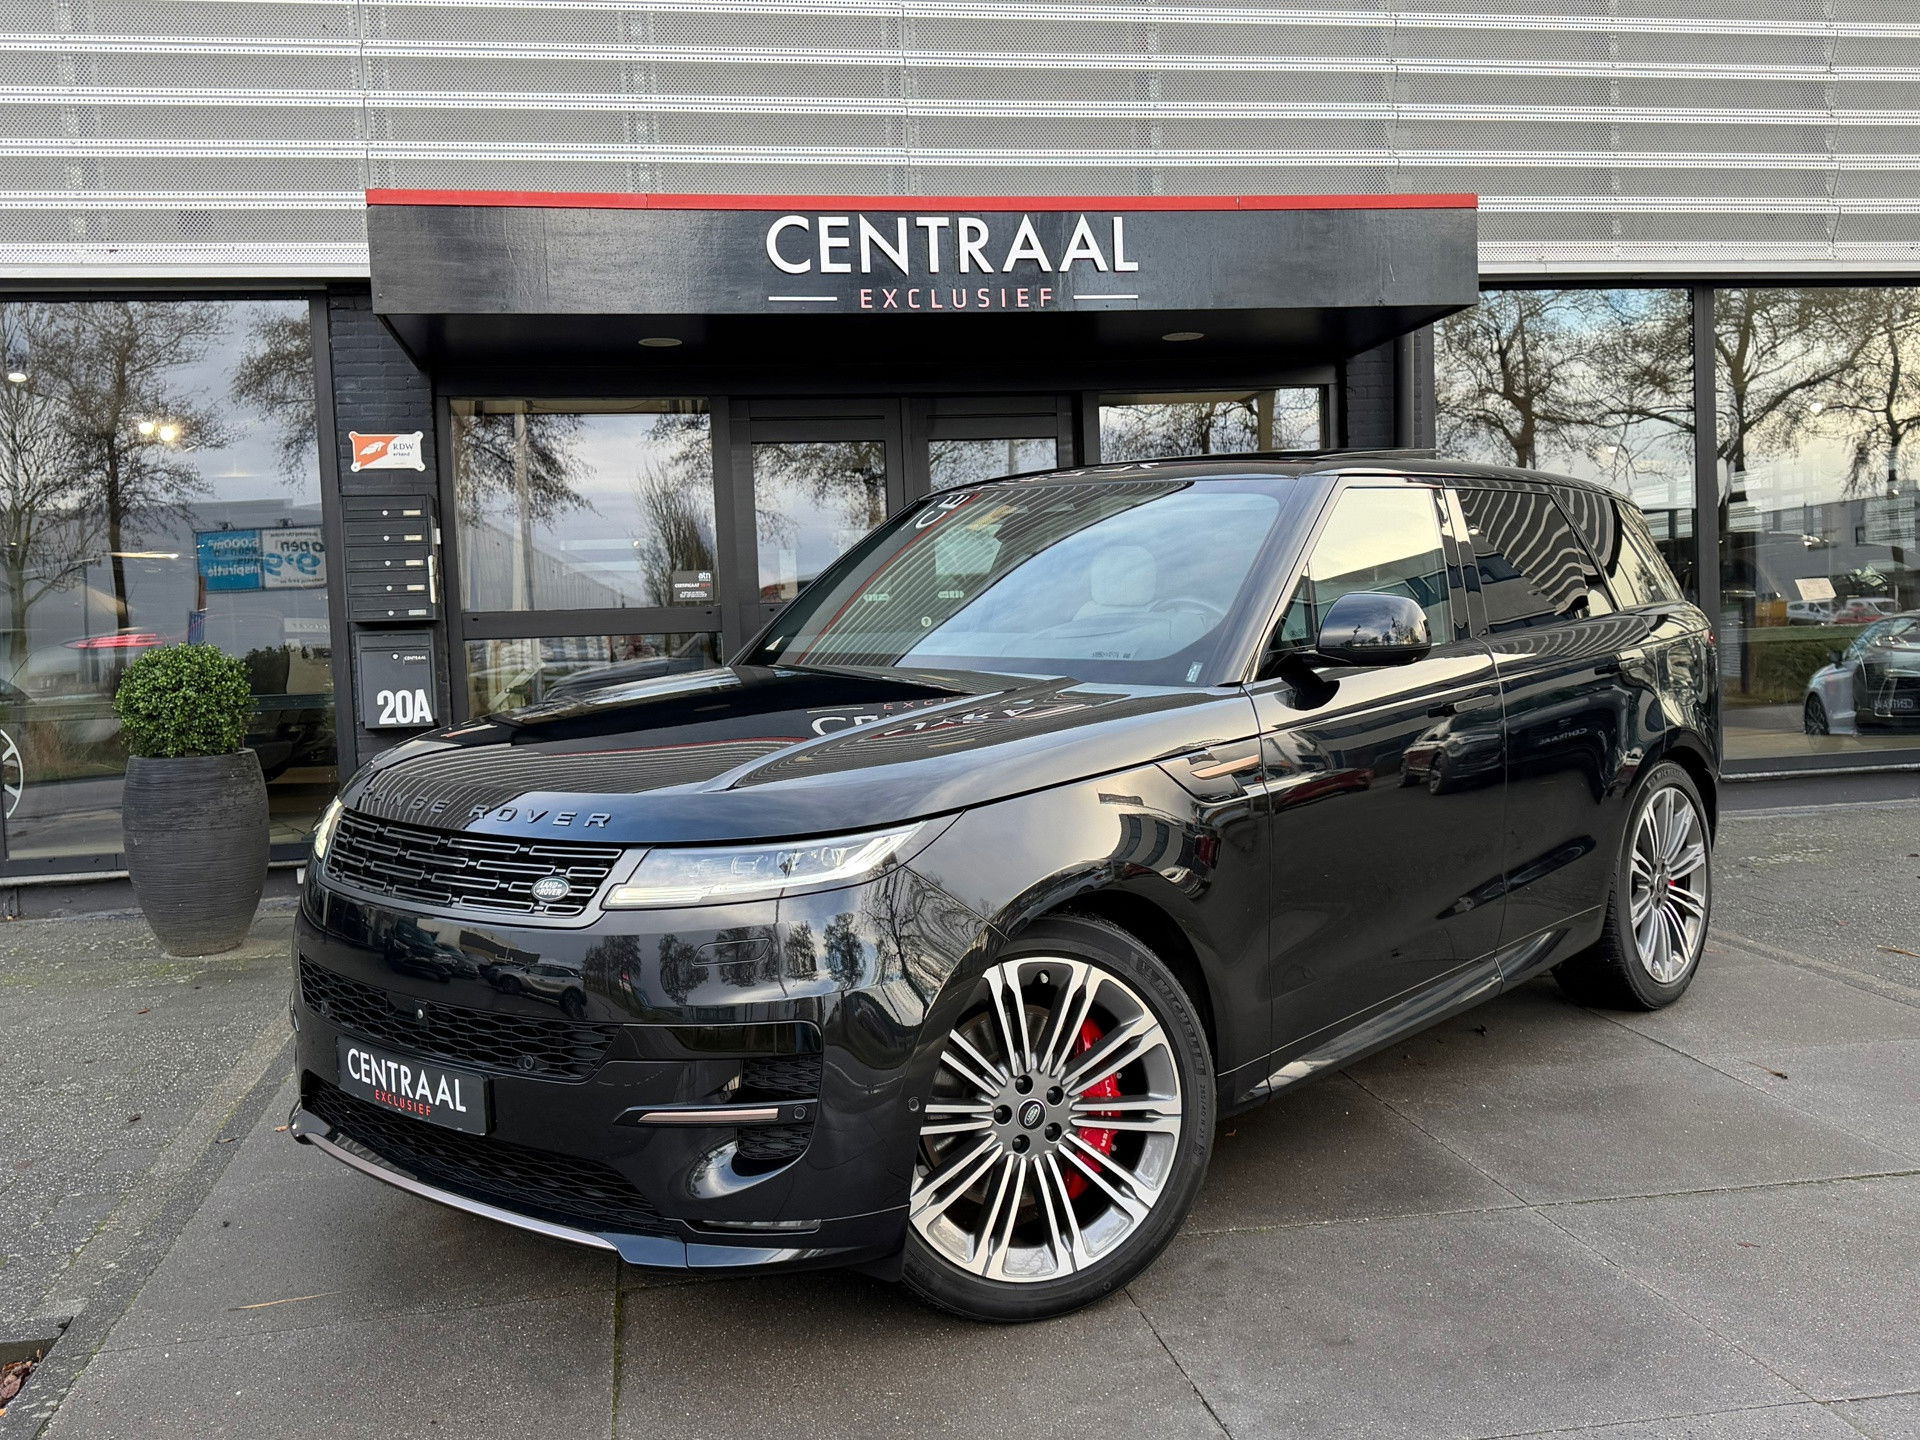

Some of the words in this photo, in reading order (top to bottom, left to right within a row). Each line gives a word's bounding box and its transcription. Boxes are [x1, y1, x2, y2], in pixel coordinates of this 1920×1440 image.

[766, 213, 1139, 276] CENTRAAL
[860, 288, 1053, 309] EXCLUSIEF
[377, 689, 433, 725] 20A
[361, 786, 450, 813] RANGE
[468, 804, 612, 829] ROVER
[1156, 977, 1206, 1075] MICHELIN
[347, 1048, 467, 1113] CENTRAAL
[375, 1089, 431, 1117] EXCLUSIEF
